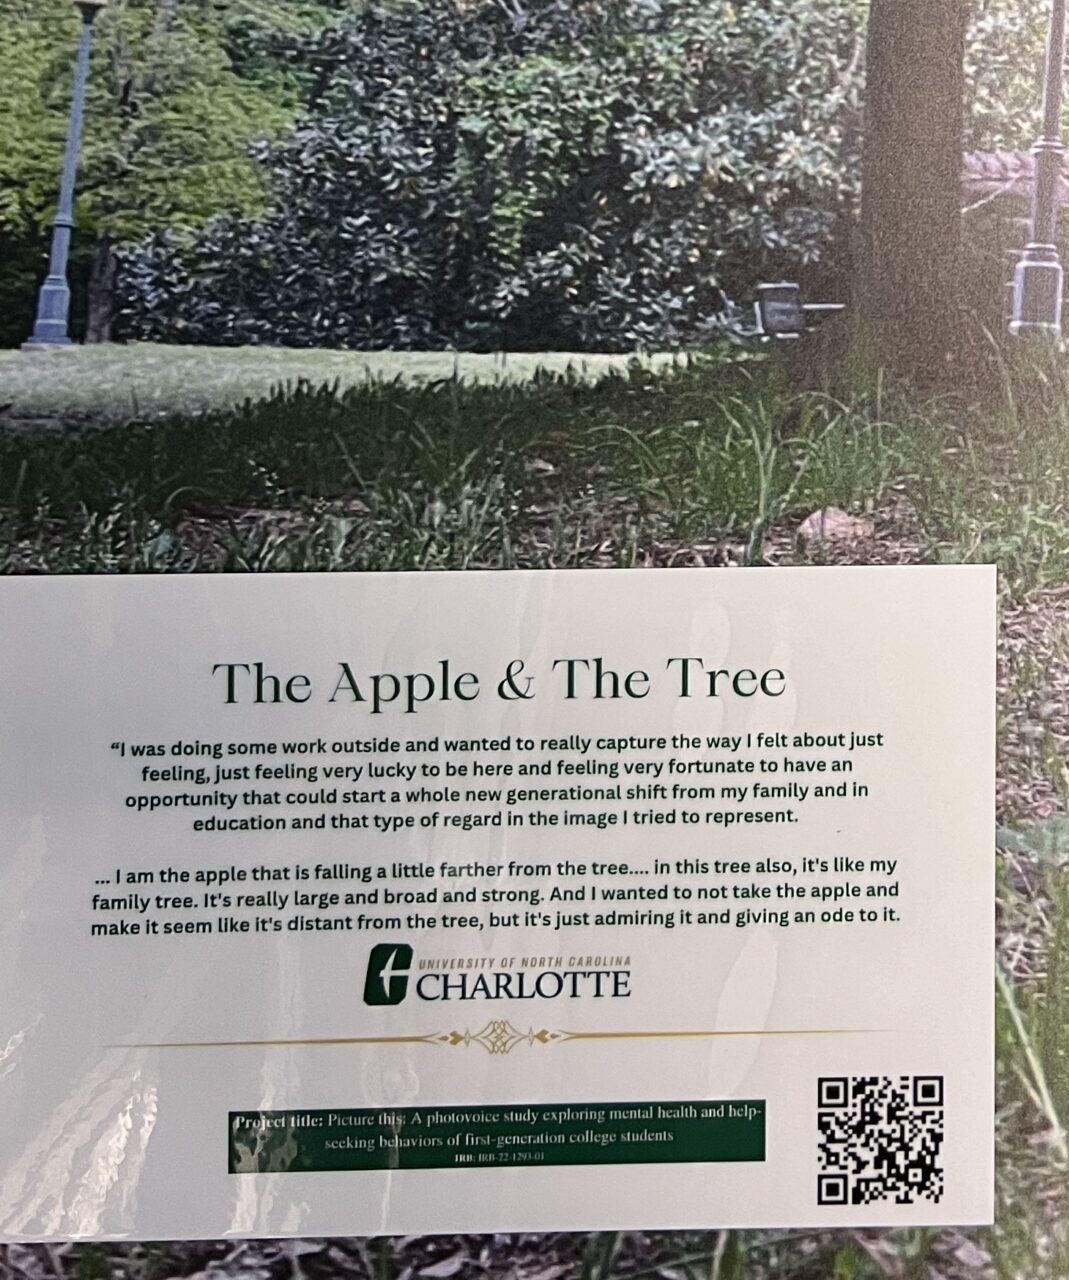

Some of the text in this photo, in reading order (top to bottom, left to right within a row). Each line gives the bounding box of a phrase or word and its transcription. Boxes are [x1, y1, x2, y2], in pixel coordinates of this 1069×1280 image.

[211, 656, 786, 715] The Apple & The Tree
[130, 744, 167, 758] was
[170, 739, 224, 760] doing
[226, 742, 278, 756] some
[281, 737, 328, 755] work
[330, 736, 401, 754] outside
[404, 736, 440, 753] and
[443, 735, 512, 753] wanted
[515, 736, 536, 752] to
[540, 734, 592, 755] really
[595, 735, 668, 755] capture
[670, 732, 702, 750] the
[705, 736, 743, 753] way
[746, 732, 752, 749] I
[756, 731, 789, 749] felt
[792, 732, 846, 748] about
[848, 731, 885, 751] just
[141, 756, 853, 786] feeling, just feeling very lucky to be here and feeling very fortunate to have an
[124, 780, 869, 812] opportunity that could start a whole new generational shift from my family and in
[192, 808, 799, 833] education and that type of regard in the image I tried to represent.
[115, 868, 121, 885] I
[125, 871, 155, 885] am
[158, 866, 191, 884] the
[194, 865, 248, 887] apple
[250, 864, 291, 882] that
[294, 864, 310, 881] is
[313, 863, 373, 884] falling
[376, 866, 388, 879] a
[391, 862, 436, 879] little
[439, 861, 505, 878] farther
[507, 860, 552, 878] from
[555, 859, 587, 877] the
[590, 861, 650, 876] tree....
[654, 858, 671, 876] in
[674, 858, 710, 875] this
[713, 859, 752, 874] tree
[755, 857, 798, 878] also,
[802, 856, 829, 874] it's
[833, 856, 866, 873] like
[869, 859, 898, 876] my
[91, 880, 900, 913] family tree. It's really large and broad and strong. And I wanted to not take the apple and
[90, 905, 901, 937] make it seem like it's distant from the tree, but it's just admiring it and giving an ode to it.
[417, 955, 631, 970] UNIVERSITY OF NORTH CAROLINA
[415, 970, 632, 1002] CHARLOTTE
[236, 1104, 762, 1131] Project title: Picture this: A photovoice study exploring mental health and help-
[324, 1129, 674, 1151] seeking behaviors of first-generation college students
[455, 1153, 476, 1163] IRB:
